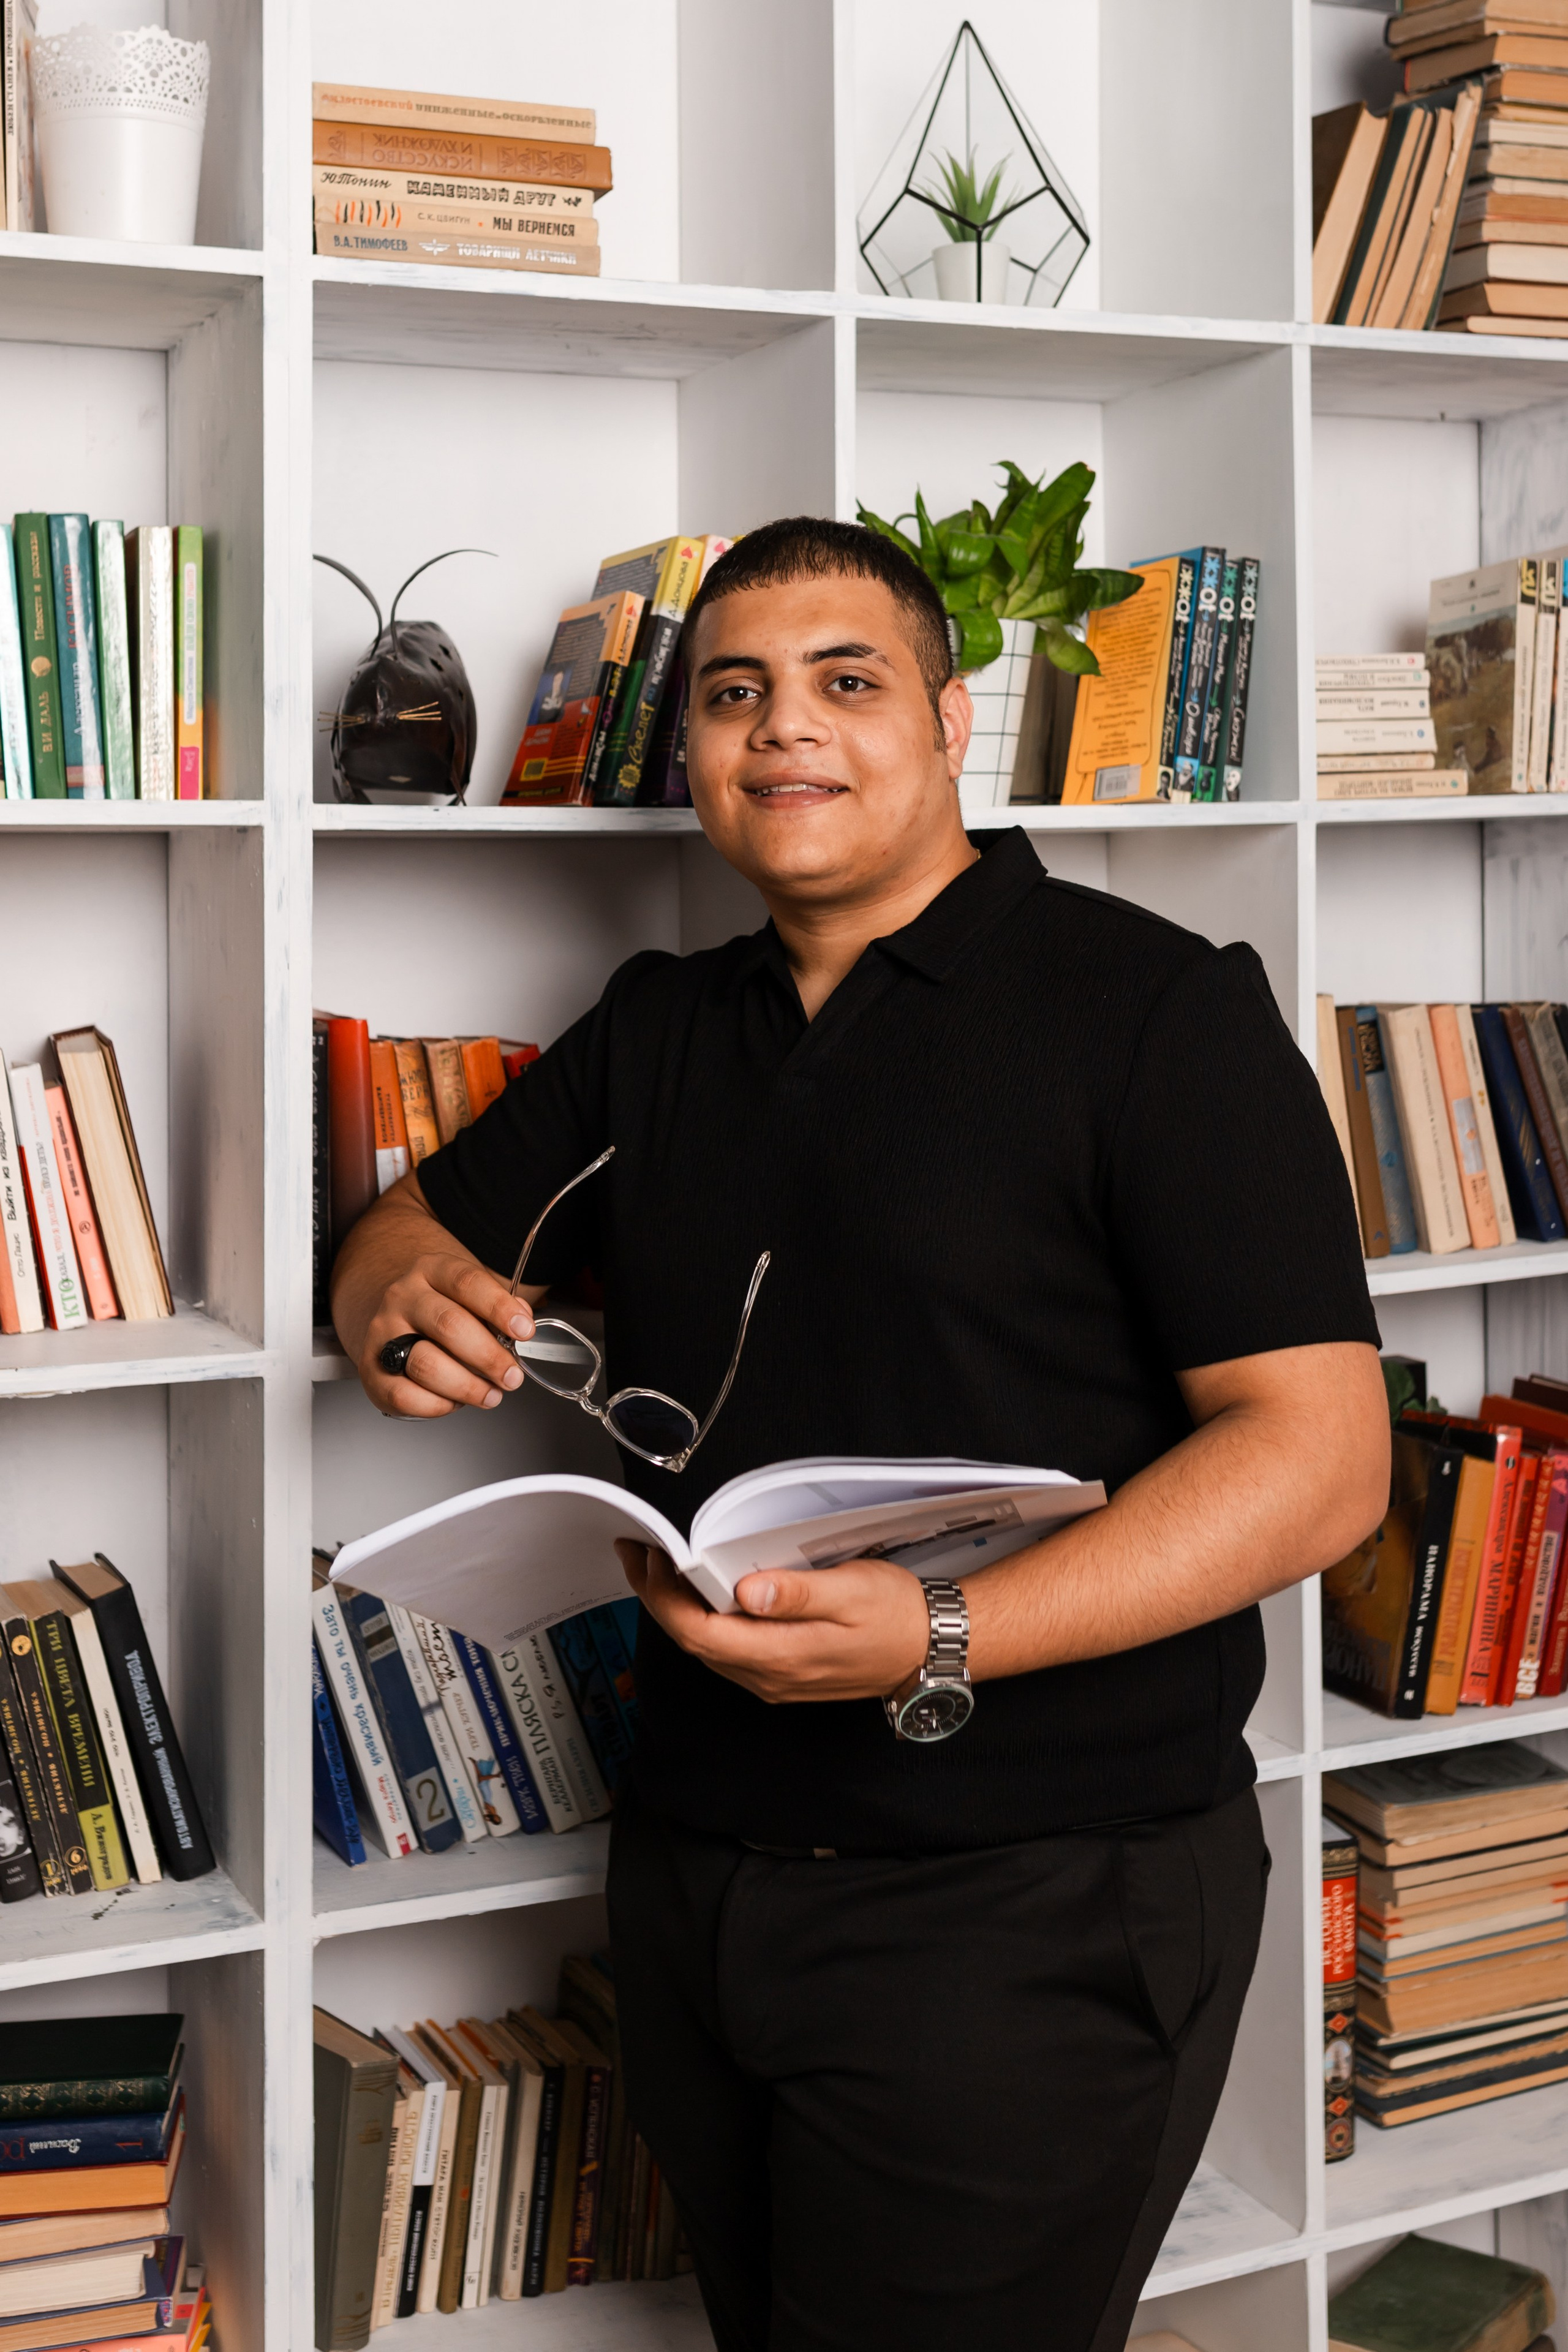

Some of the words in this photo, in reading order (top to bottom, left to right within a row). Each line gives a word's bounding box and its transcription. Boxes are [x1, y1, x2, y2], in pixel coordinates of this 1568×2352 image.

[371, 148, 473, 171] ИСКУССТВО
[372, 133, 460, 154] ХУДОЖНИК
[461, 141, 473, 155] И
[407, 180, 509, 203] КАМЕННЫЙ
[513, 190, 557, 208] ДРУГ
[353, 236, 409, 252] ТИМОФЕЕВ
[456, 242, 521, 260] ТОВАРИЩИ
[524, 247, 577, 265] ЛЕТЧИКИ
[492, 216, 512, 232] МЫ
[517, 217, 576, 238] ВЕРНЕМСЯ
[33, 596, 45, 641] Повести
[627, 701, 656, 765] Скелет
[3, 1163, 11, 1180] из
[7, 1186, 18, 1221] Выйти
[59, 1277, 80, 1320] КТО
[1416, 1544, 1439, 1621] ПАНОРАМА
[1478, 1559, 1504, 1653] МАРИНИНА
[44, 1620, 64, 1652] ТРИ
[53, 1655, 74, 1709] ЦВЕТА
[123, 1649, 165, 1746] ЭЛЕКТРОПРИВОД
[321, 1603, 341, 1637] Зато
[335, 1642, 347, 1659] ты
[341, 1662, 360, 1702] очень
[352, 1703, 385, 1767] красивый
[1, 1697, 23, 1755] ПОЛИТИКА
[31, 1691, 51, 1750] ПОЛИТИКА
[477, 1673, 511, 1747] ПРИКЛЮЧЕНИЯ
[510, 1676, 551, 1755] ПЛЯСКА
[63, 1712, 95, 1789] ВРЕМЕНИ
[20, 1766, 41, 1823] ДЕТЕКТИВ
[48, 1762, 69, 1815] ДЕТЕКТИВ
[417, 1777, 446, 1823] 2
[518, 1786, 538, 1820] МАРК
[545, 1755, 572, 1813] КЕЛЛЕРМАН
[1331, 1883, 1344, 1975] РОССИЙСКОГО
[1342, 1902, 1355, 1953] ФЛОТА
[401, 2109, 419, 2167] ЮНОСТЬ
